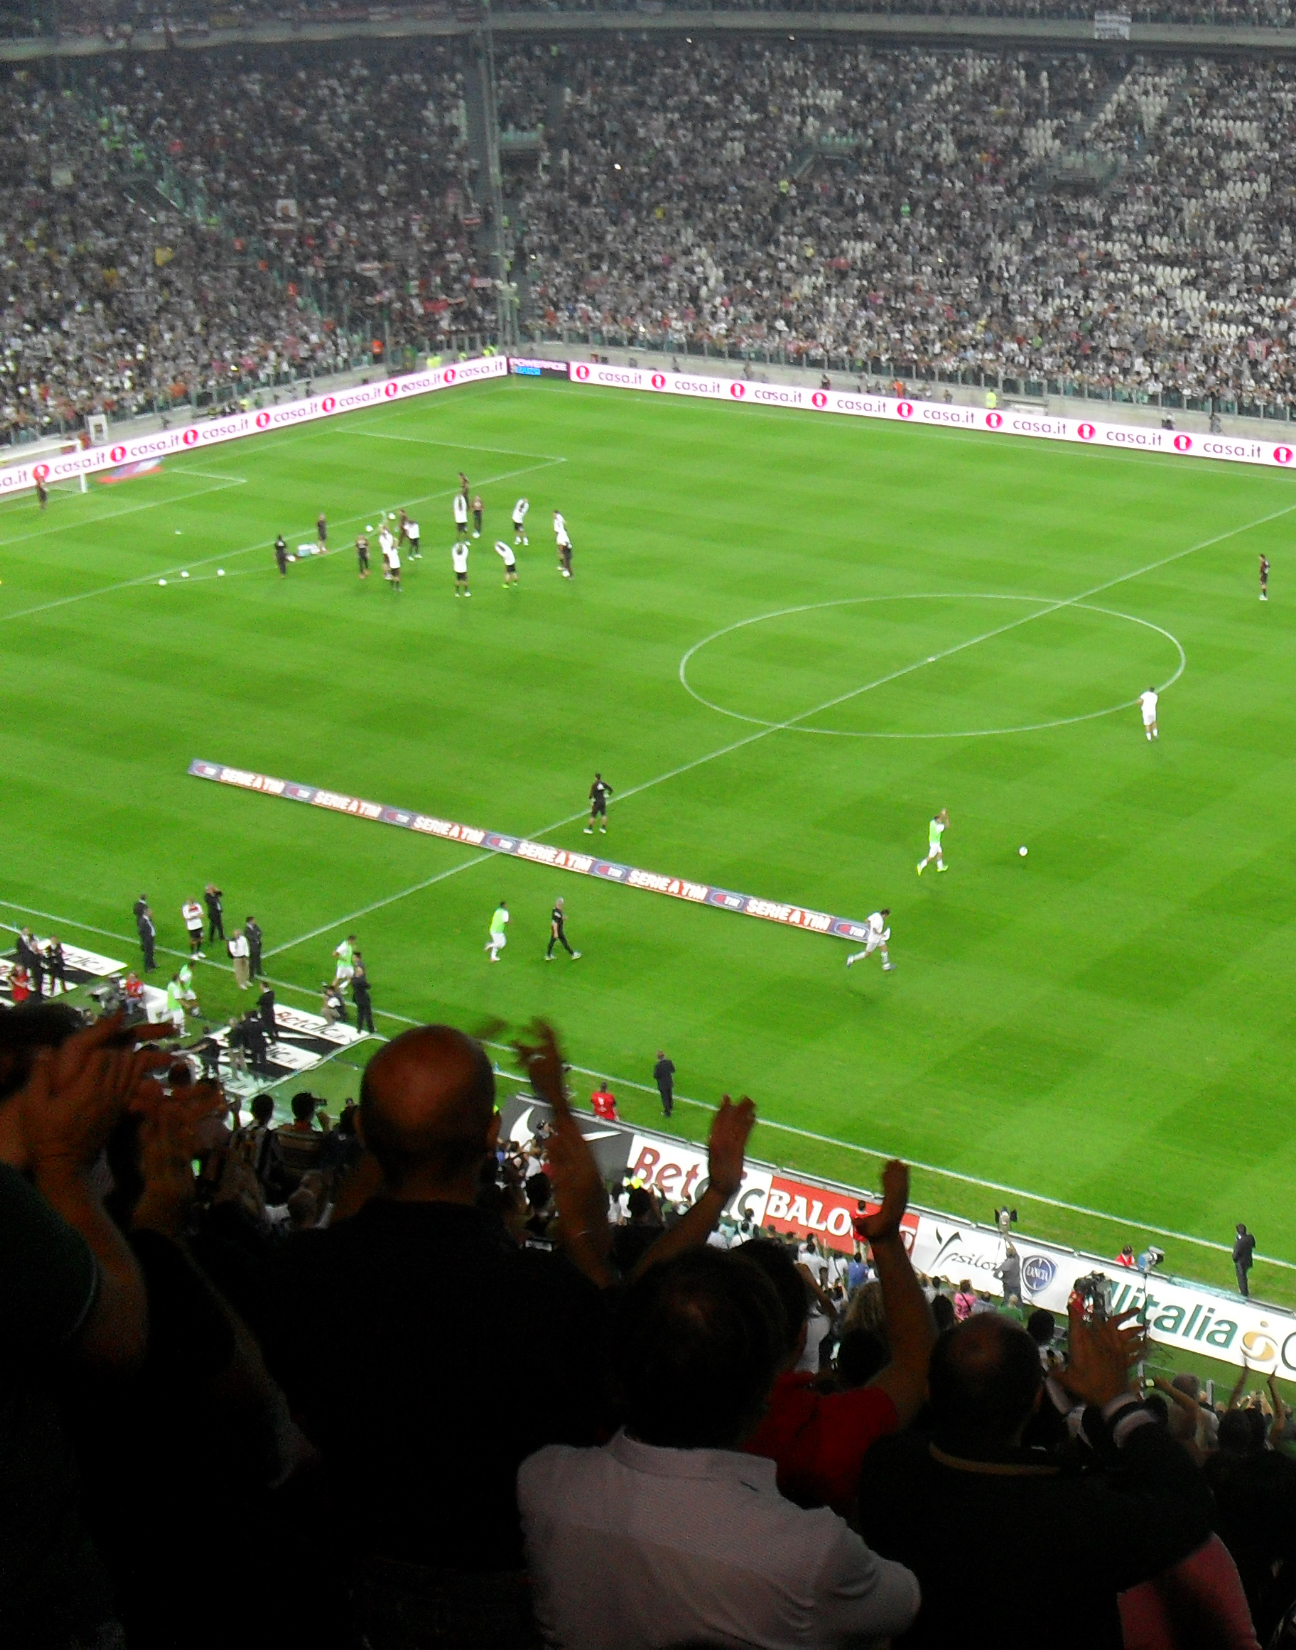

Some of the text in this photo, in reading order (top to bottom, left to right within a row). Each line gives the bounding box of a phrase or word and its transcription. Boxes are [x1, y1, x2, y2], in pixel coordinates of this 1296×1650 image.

[458, 362, 503, 380] casa.it
[599, 373, 641, 383] casa.it
[675, 380, 720, 392] casa.it
[755, 390, 801, 401] casa.it
[339, 389, 382, 406] casa.it
[838, 399, 885, 412] casa.it
[274, 403, 318, 423] casa.it
[924, 409, 974, 423] casa.it
[202, 419, 249, 440] casa.it
[1013, 420, 1065, 434] casa.it
[130, 435, 180, 457] casa.it
[1107, 431, 1161, 445] casa.it
[1204, 442, 1260, 457] casa.it
[54, 453, 106, 475] casa.it
[219, 768, 285, 794] SERIE A TIM
[313, 791, 382, 818] SERIE A TIM
[414, 816, 484, 844] SERIE A TIM
[517, 841, 592, 872] SERIE A TIM
[627, 871, 708, 901] SERIE A TIM
[744, 899, 832, 931] SERIE A TIM
